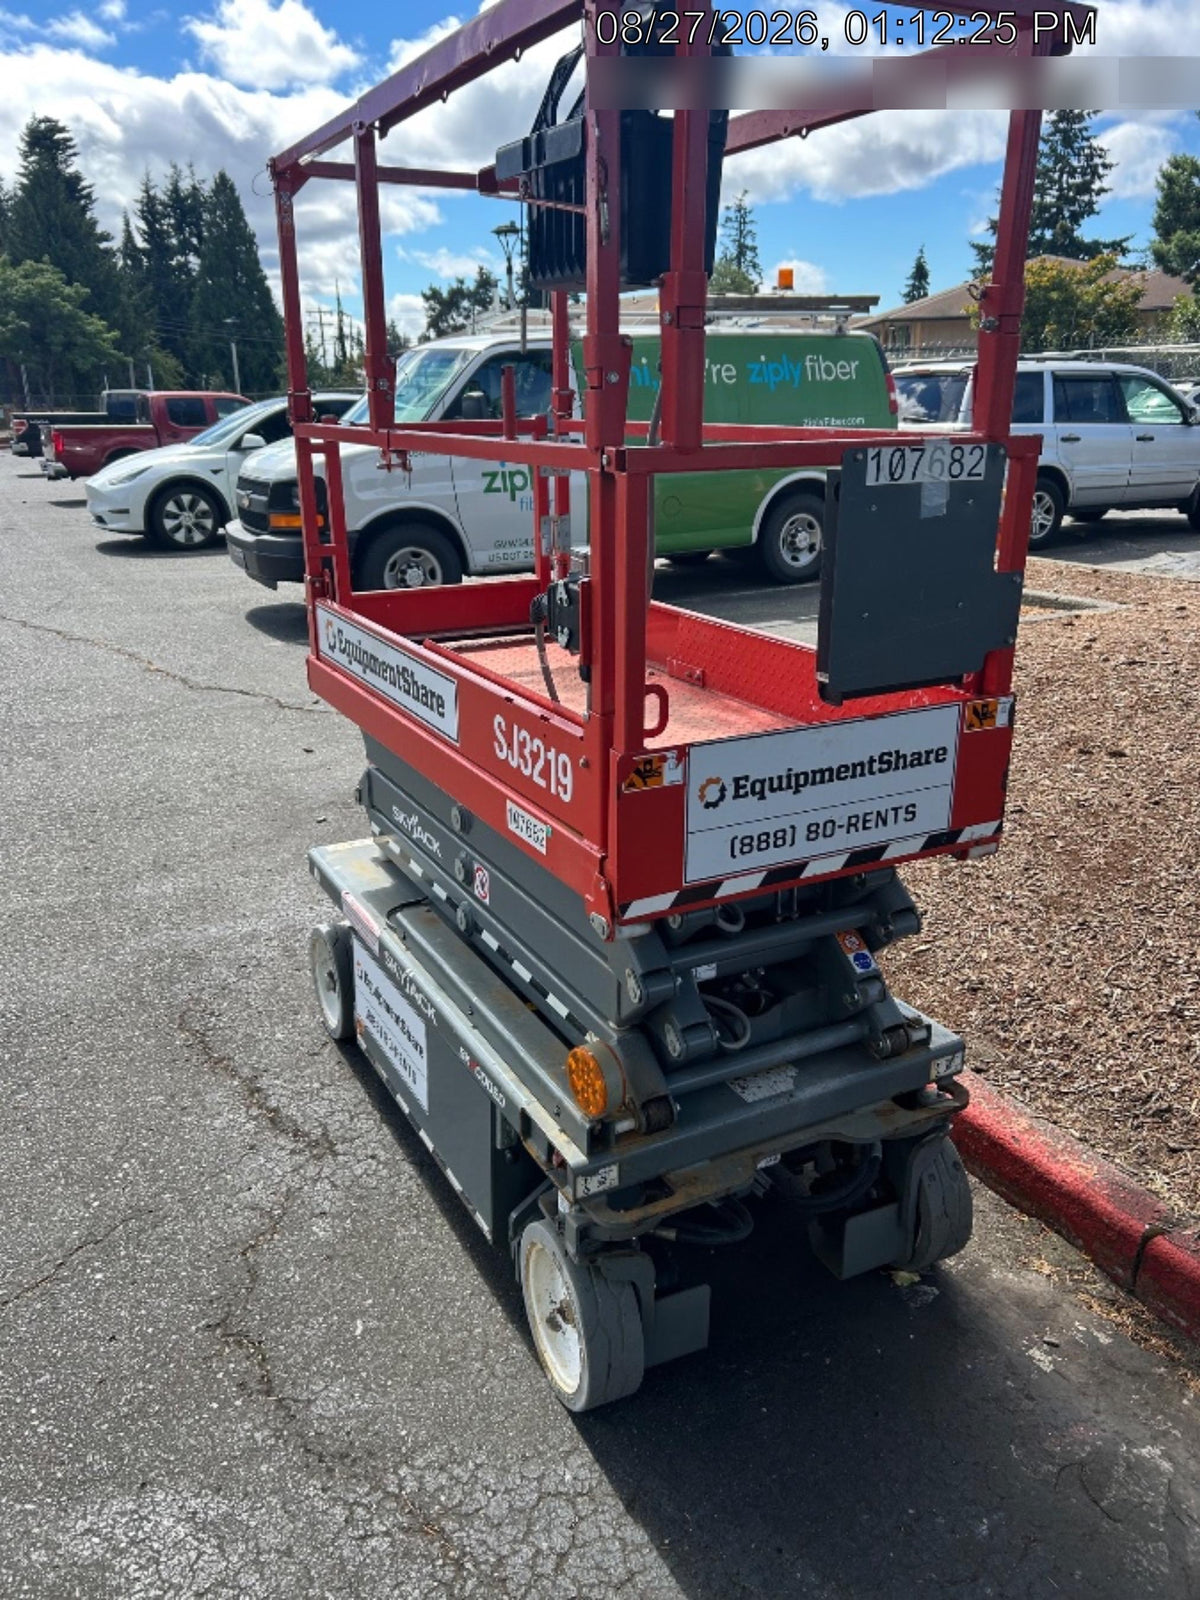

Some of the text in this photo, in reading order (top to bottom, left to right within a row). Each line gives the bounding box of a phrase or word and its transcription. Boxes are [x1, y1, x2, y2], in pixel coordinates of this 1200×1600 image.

[746, 354, 802, 392] ziply
[805, 355, 859, 382] fiber
[481, 461, 534, 502] zipl
[870, 445, 985, 482] 107682
[337, 628, 446, 718] EquipmentShare
[493, 714, 574, 803] SJ3219
[731, 746, 948, 801] EquipmentShare
[730, 803, 917, 859] (888) 80-RENTS
